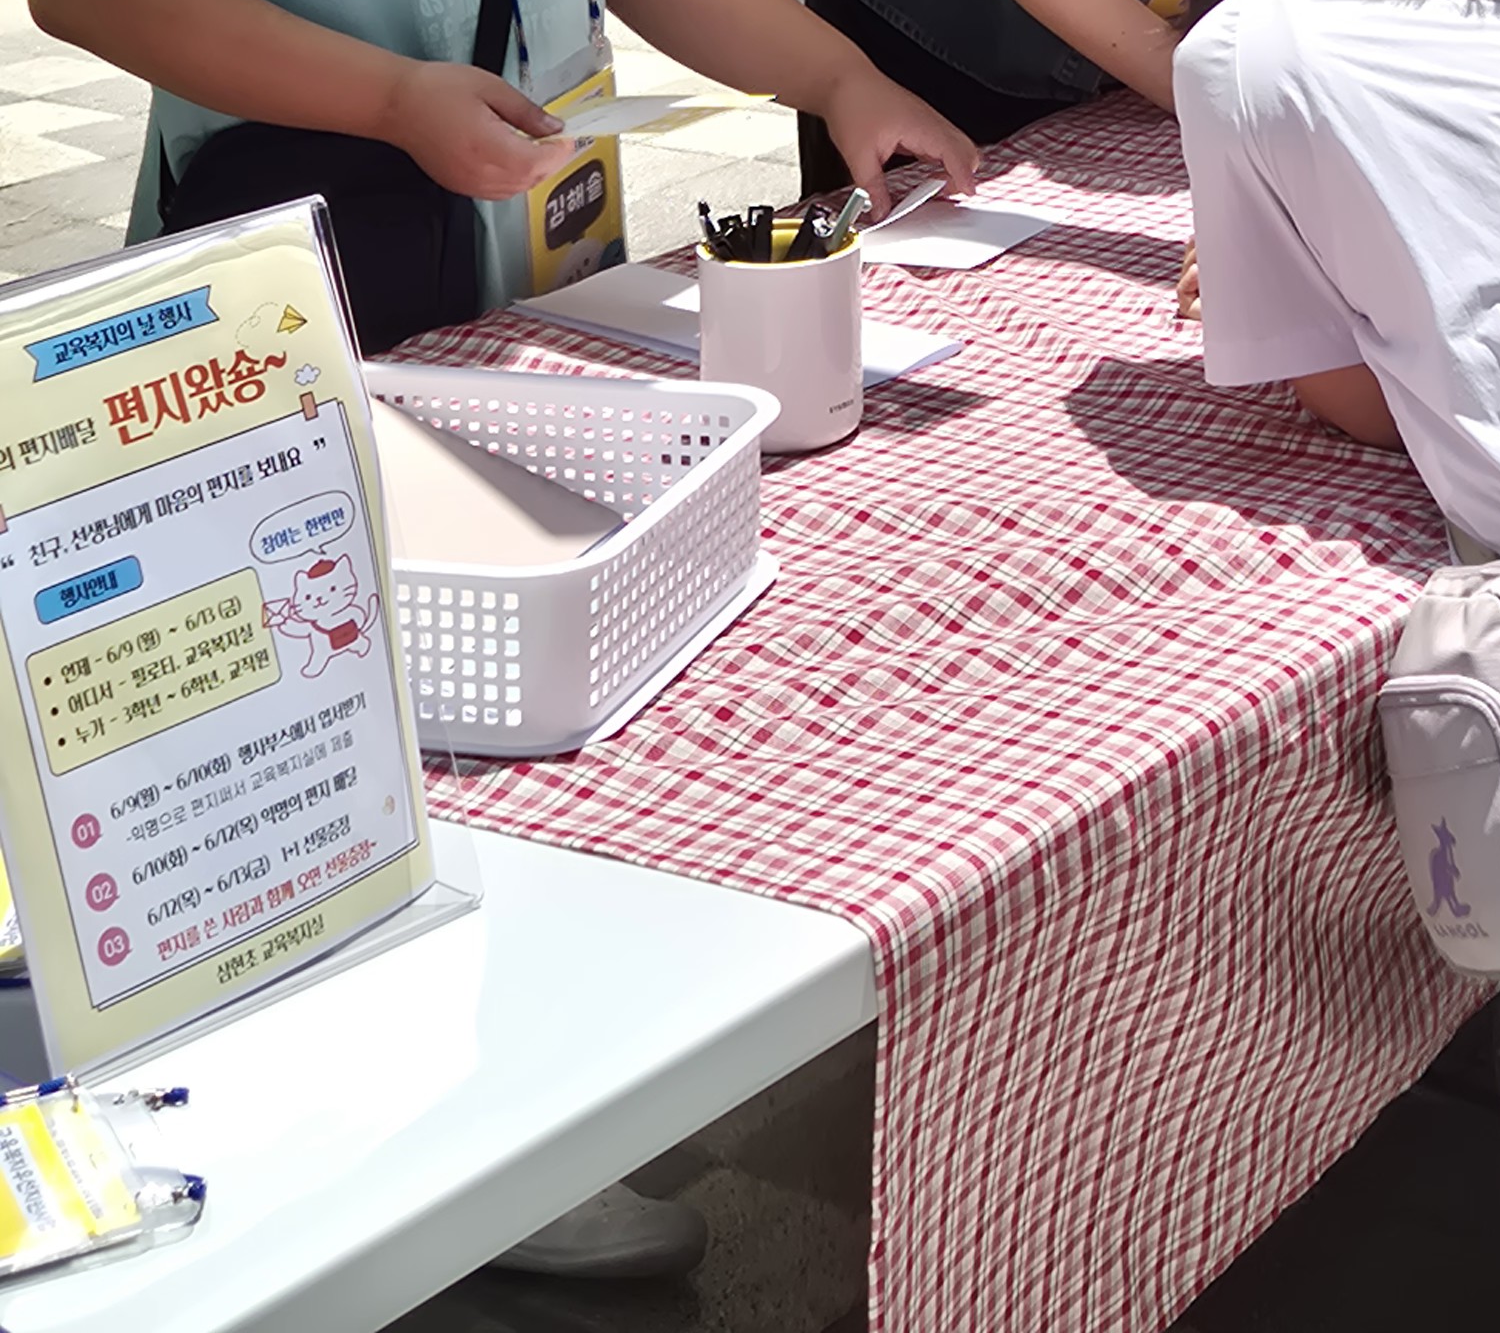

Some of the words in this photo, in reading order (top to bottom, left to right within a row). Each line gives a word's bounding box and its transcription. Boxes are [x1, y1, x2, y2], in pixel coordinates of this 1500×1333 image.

[53, 320, 134, 364] 교육복지의
[137, 315, 155, 335] 날
[158, 300, 193, 330] 행사
[18, 416, 98, 464] 편지배달
[103, 349, 287, 446] 편지왔숑~
[70, 504, 153, 551] 선생님에게
[155, 483, 203, 517] 마음의
[206, 464, 254, 502] 편지를
[256, 446, 302, 479] 보내요
[261, 528, 302, 555] 참여는
[304, 507, 345, 538] 한번만
[58, 571, 117, 609] 행사안내
[60, 657, 92, 683] 언제
[106, 641, 134, 664] 6/9
[136, 628, 161, 653] (월)
[185, 608, 215, 631] 6/13
[218, 596, 242, 621] (금)
[68, 682, 114, 713] 어디서
[184, 622, 255, 666] 교육복지실
[75, 717, 105, 744] 누가
[124, 694, 162, 724] 3학년
[227, 648, 270, 679] 교직원
[110, 783, 160, 820] 6/9(월)
[176, 754, 232, 791] 6/10(화)
[237, 718, 317, 766] 행사부스에서
[318, 691, 367, 728] 엽서받기
[191, 782, 246, 819] 편지써서
[250, 746, 327, 791] 교육복지실에
[331, 729, 355, 754] 제출
[77, 822, 96, 841] 01
[132, 847, 188, 885] 6/10(화)
[204, 814, 259, 851] 6/12(목)
[260, 796, 304, 824] 익명의
[305, 780, 331, 807] 편지
[334, 765, 359, 792] 배달
[91, 882, 112, 903] 02
[147, 888, 201, 927] 6/12(목)
[217, 855, 272, 893] 6/13(금)
[302, 814, 352, 855] 선물증정
[156, 927, 201, 962] 편지를
[203, 920, 219, 939] 쓴
[221, 895, 265, 930] 사람과
[267, 879, 296, 909] 함께
[297, 865, 322, 888] 오면
[103, 936, 125, 955] 03
[216, 949, 259, 985] 삼현초
[262, 914, 325, 961] 교육복지실
